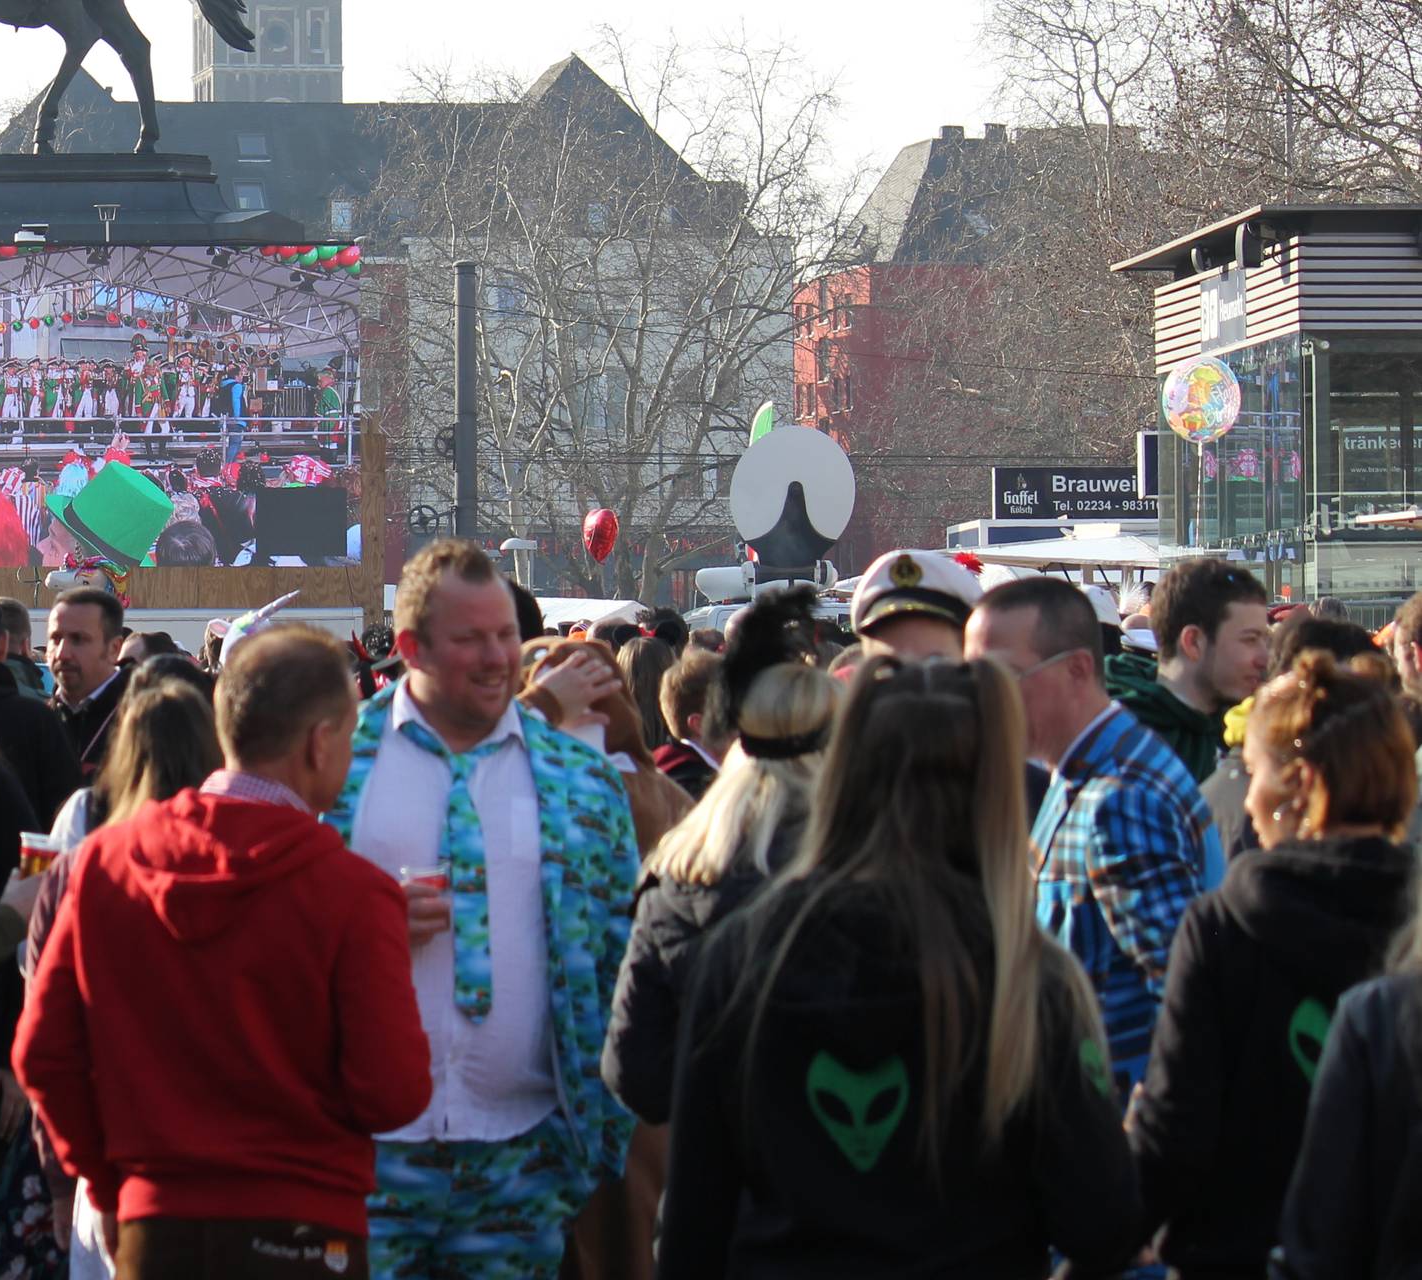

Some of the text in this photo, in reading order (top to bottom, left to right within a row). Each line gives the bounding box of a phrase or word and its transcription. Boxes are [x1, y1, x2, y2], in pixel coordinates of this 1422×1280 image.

[1052, 475, 1137, 493] Brauwei
[1003, 490, 1039, 506] Gaffel
[1053, 501, 1073, 511] Tel.
[1077, 501, 1112, 511] 02234
